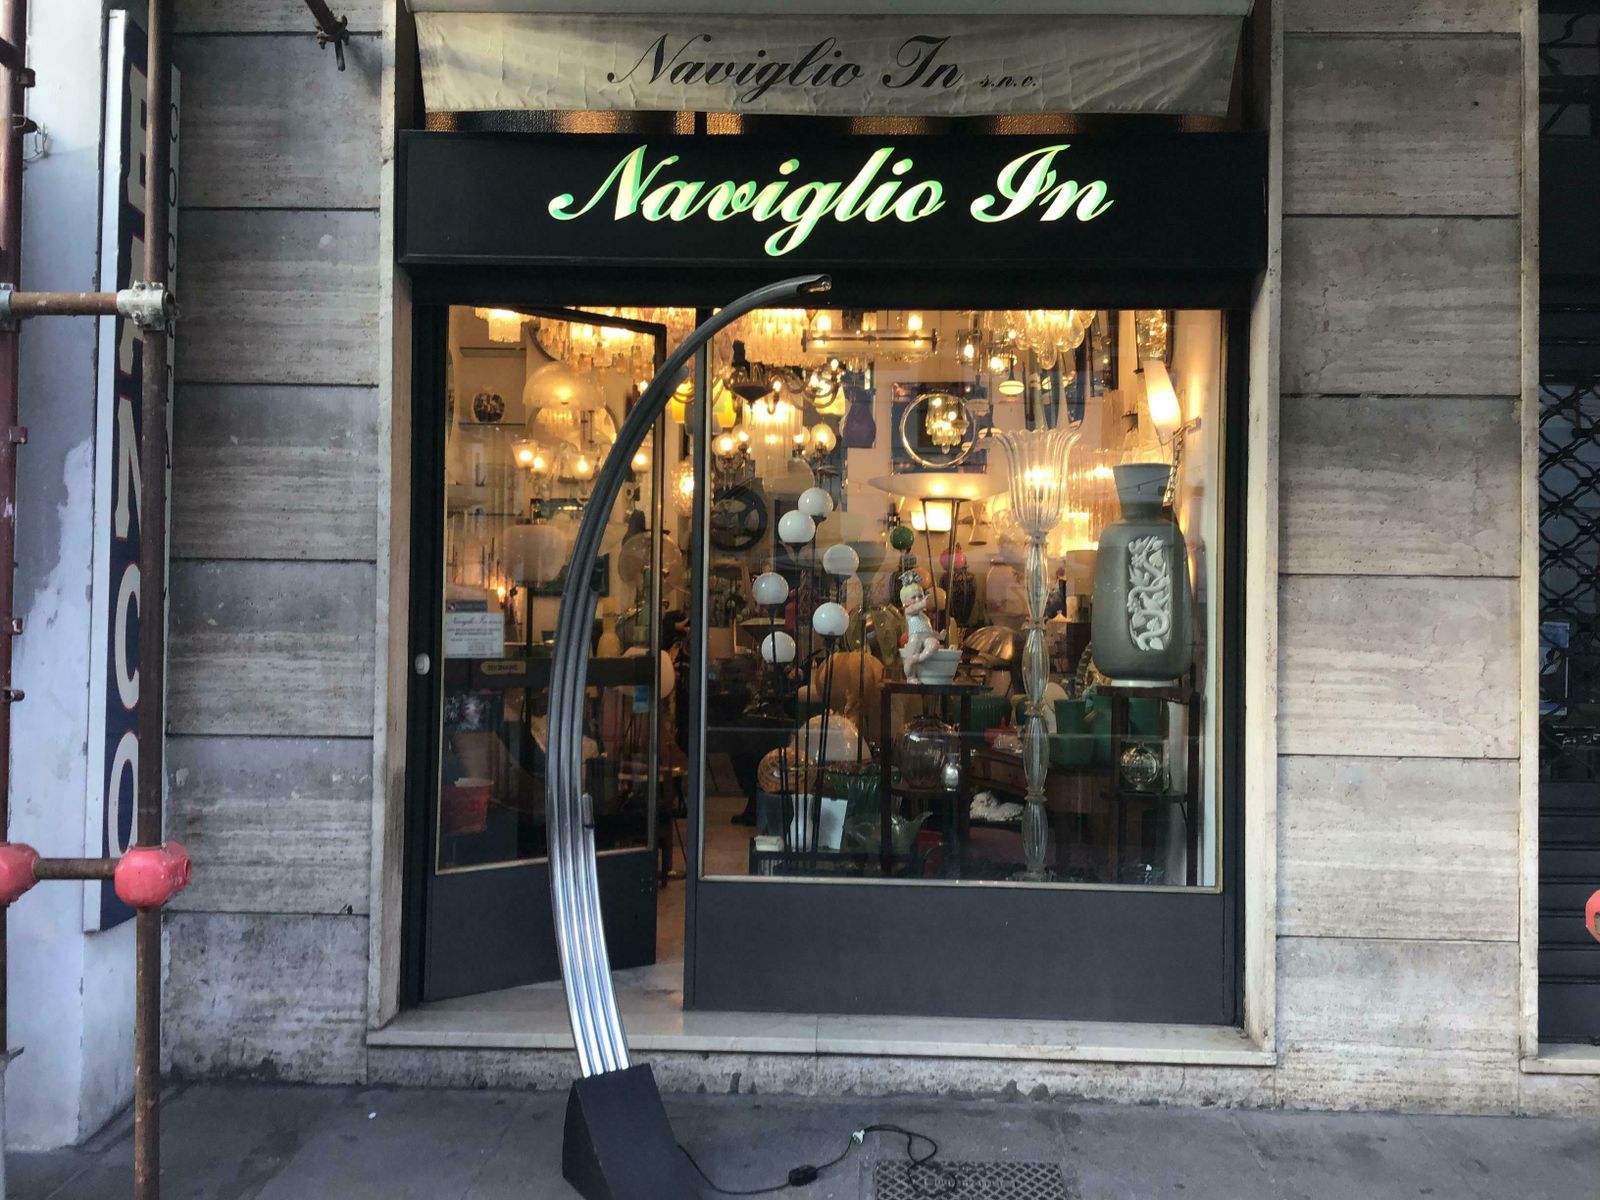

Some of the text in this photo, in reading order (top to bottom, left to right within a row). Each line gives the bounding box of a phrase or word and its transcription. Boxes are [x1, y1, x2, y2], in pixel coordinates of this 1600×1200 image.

[607, 34, 1038, 103] Naviglio In s.n.c.
[548, 144, 1115, 257] Naviglio In
